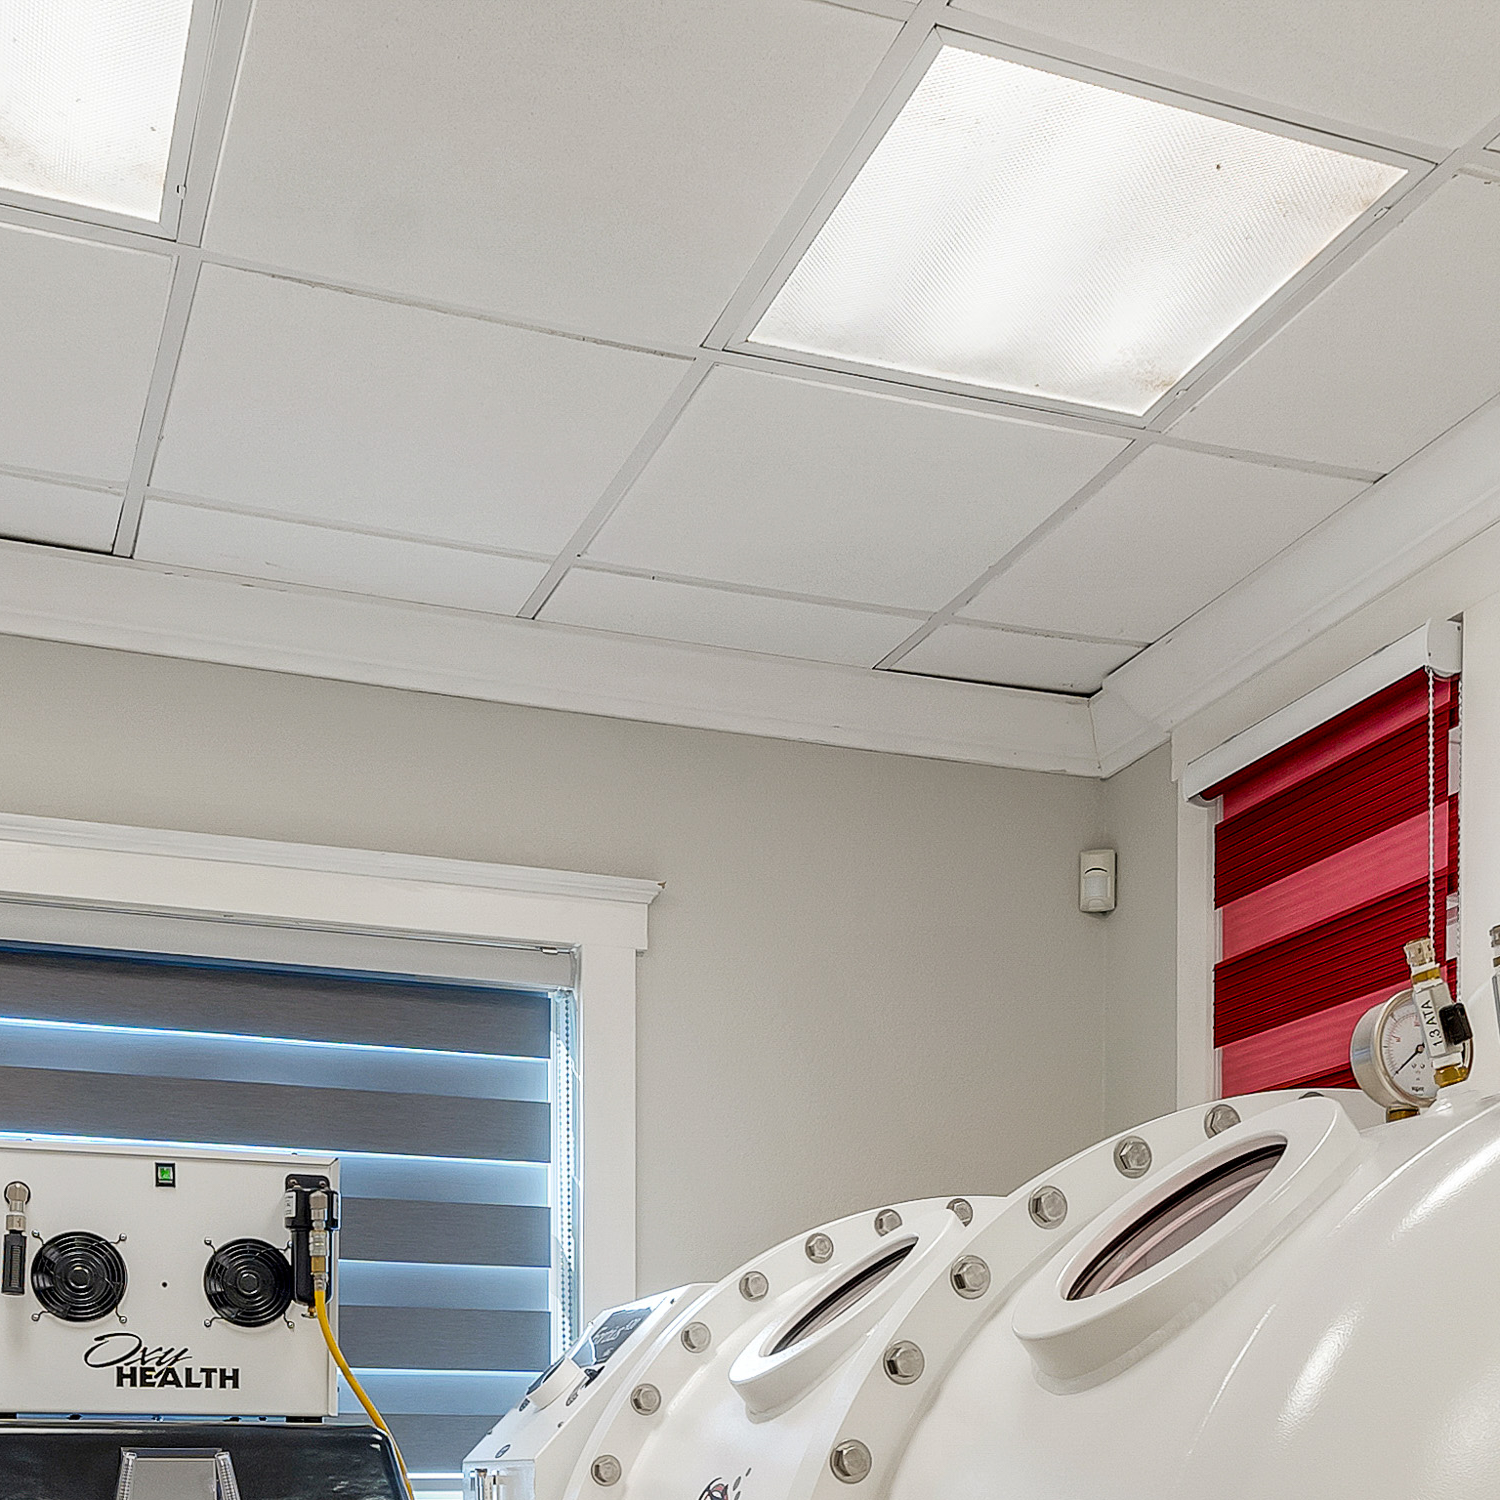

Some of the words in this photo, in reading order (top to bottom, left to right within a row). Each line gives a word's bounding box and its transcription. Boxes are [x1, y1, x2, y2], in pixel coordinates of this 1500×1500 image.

[1421, 1000, 1438, 1026] ATA
[1429, 1029, 1443, 1047] 1.3
[84, 1332, 192, 1378] Oxy
[116, 1366, 239, 1389] HEALTH
